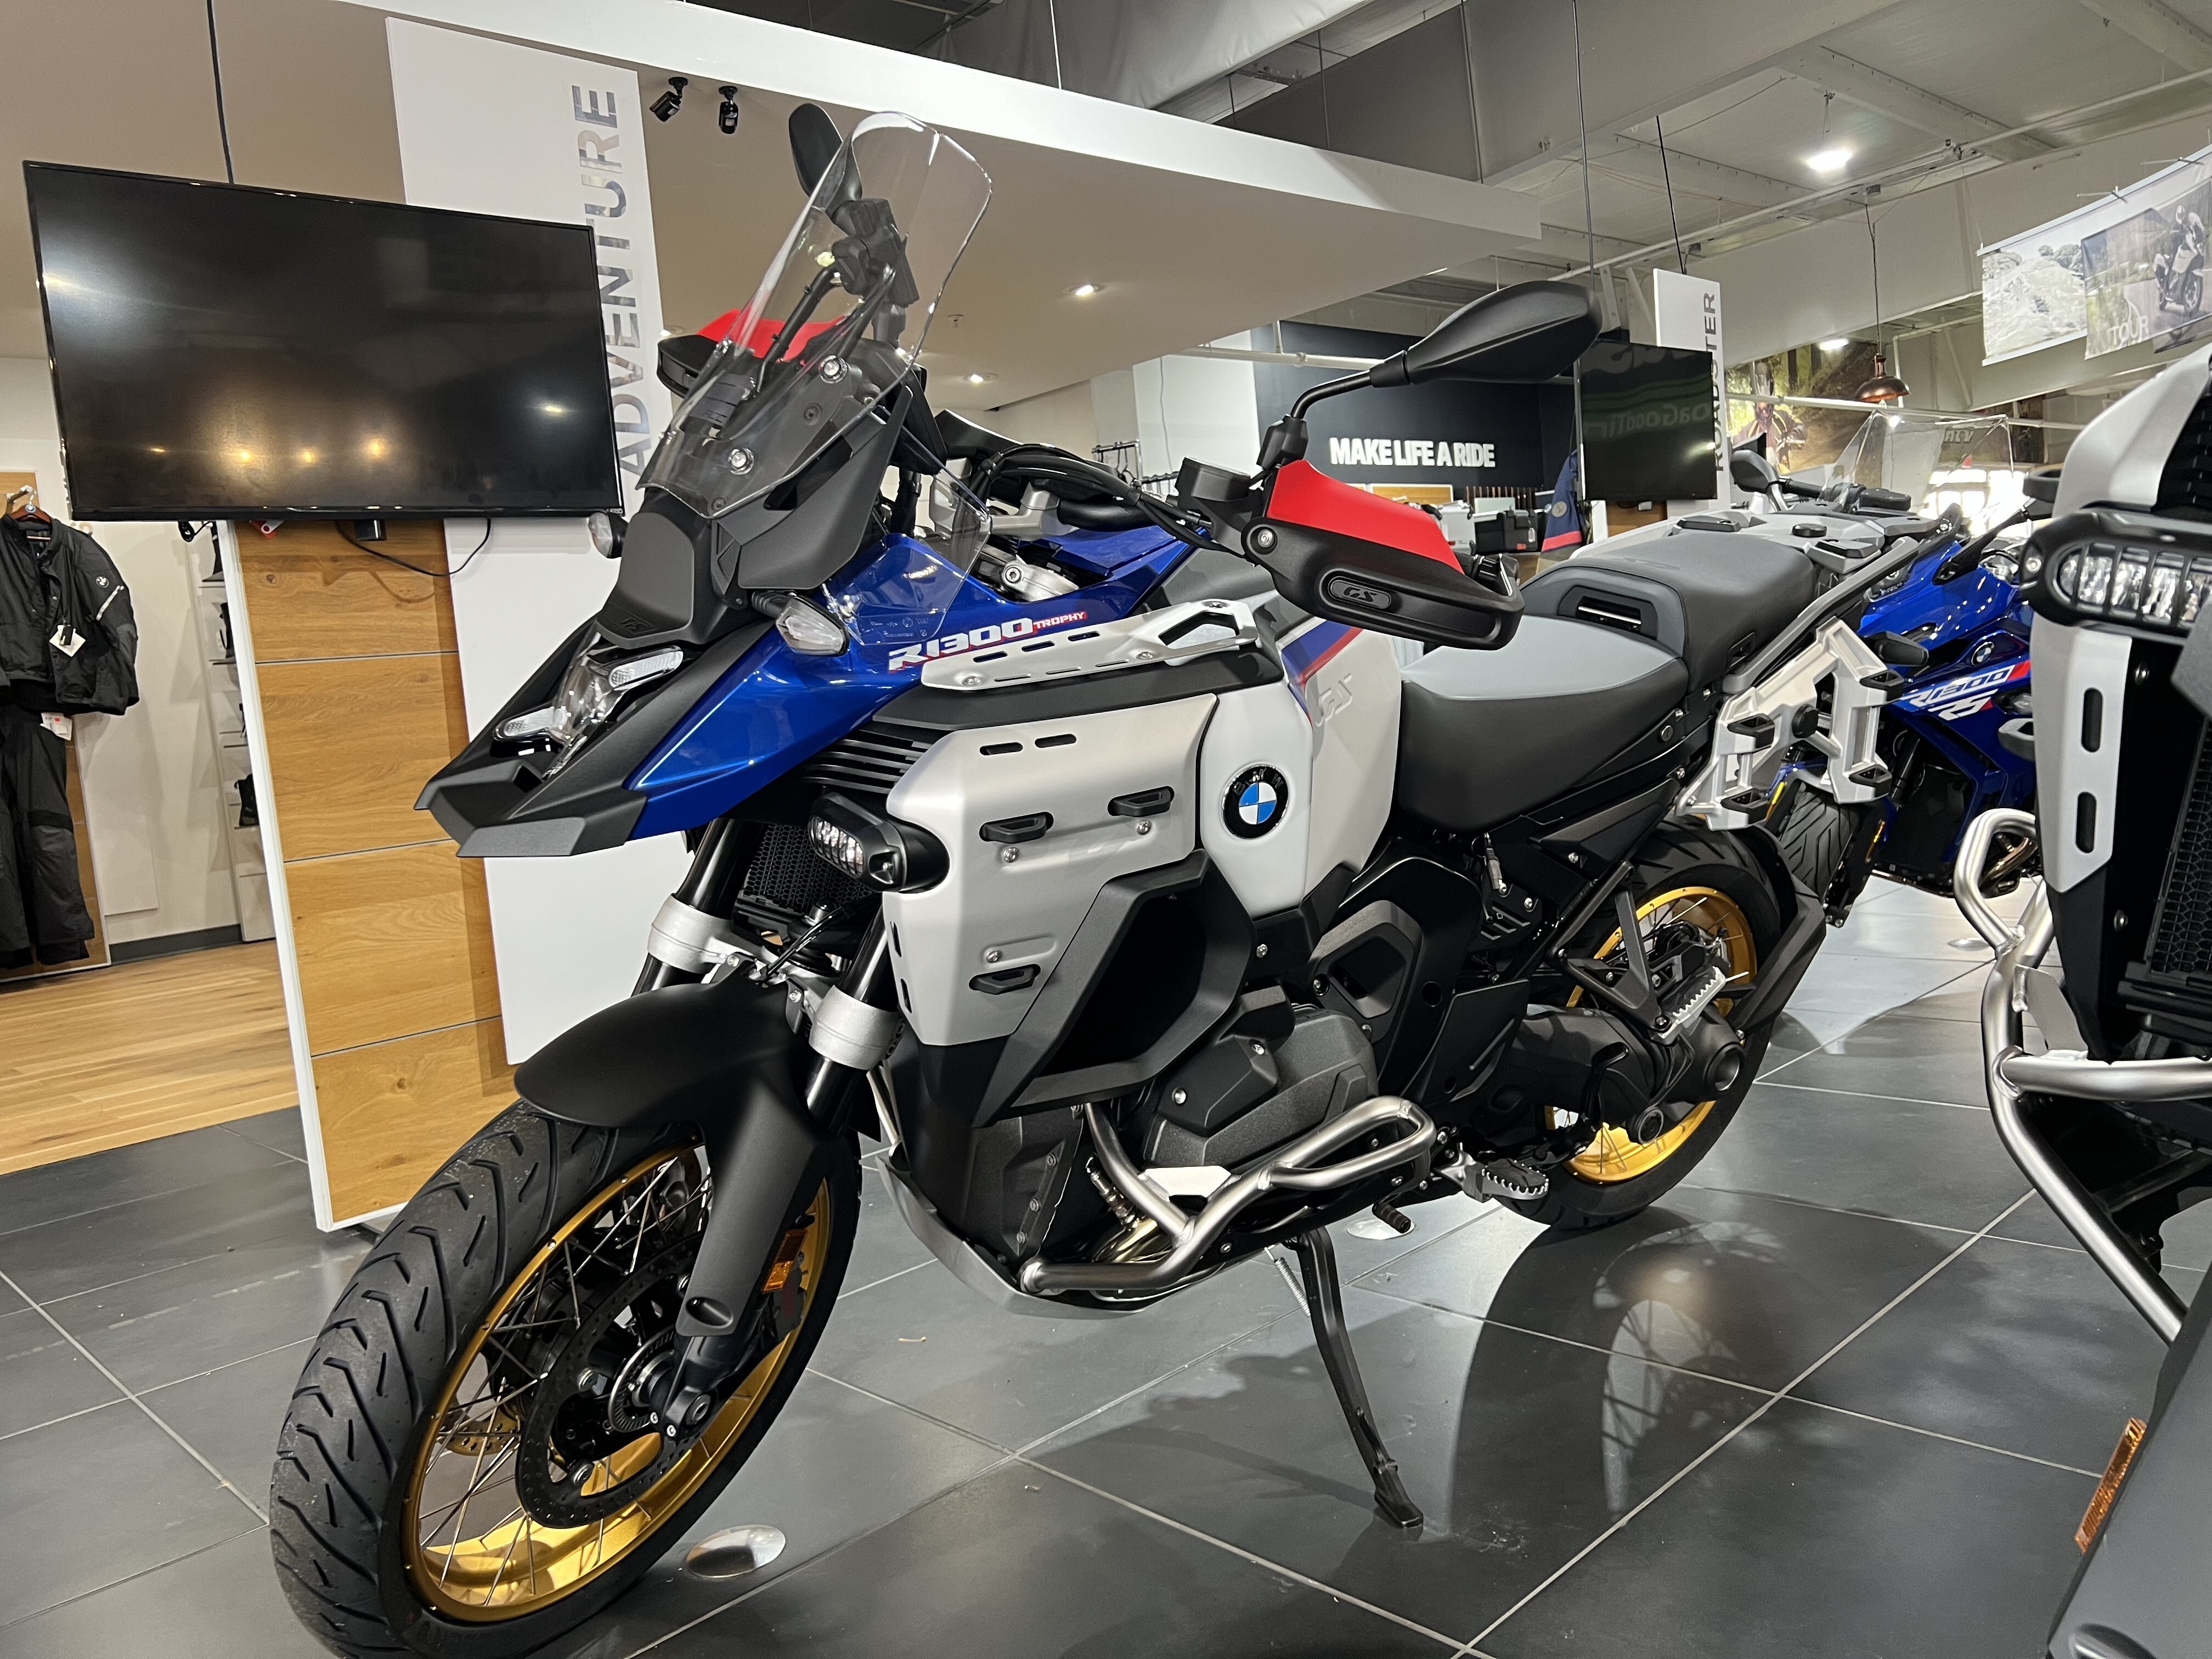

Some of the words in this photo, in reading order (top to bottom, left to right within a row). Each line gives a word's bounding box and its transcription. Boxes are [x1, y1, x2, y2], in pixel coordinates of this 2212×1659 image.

[572, 85, 652, 476] ADVENTURE
[1329, 437, 1393, 466] MAKE
[1393, 439, 1435, 466] LIFE
[1436, 441, 1453, 467] A
[1453, 442, 1496, 468] RIDE
[1344, 586, 1378, 603] GS
[1034, 611, 1087, 630] TROPHY
[1927, 688, 1999, 721] RS
[1232, 767, 1284, 796] BMW
